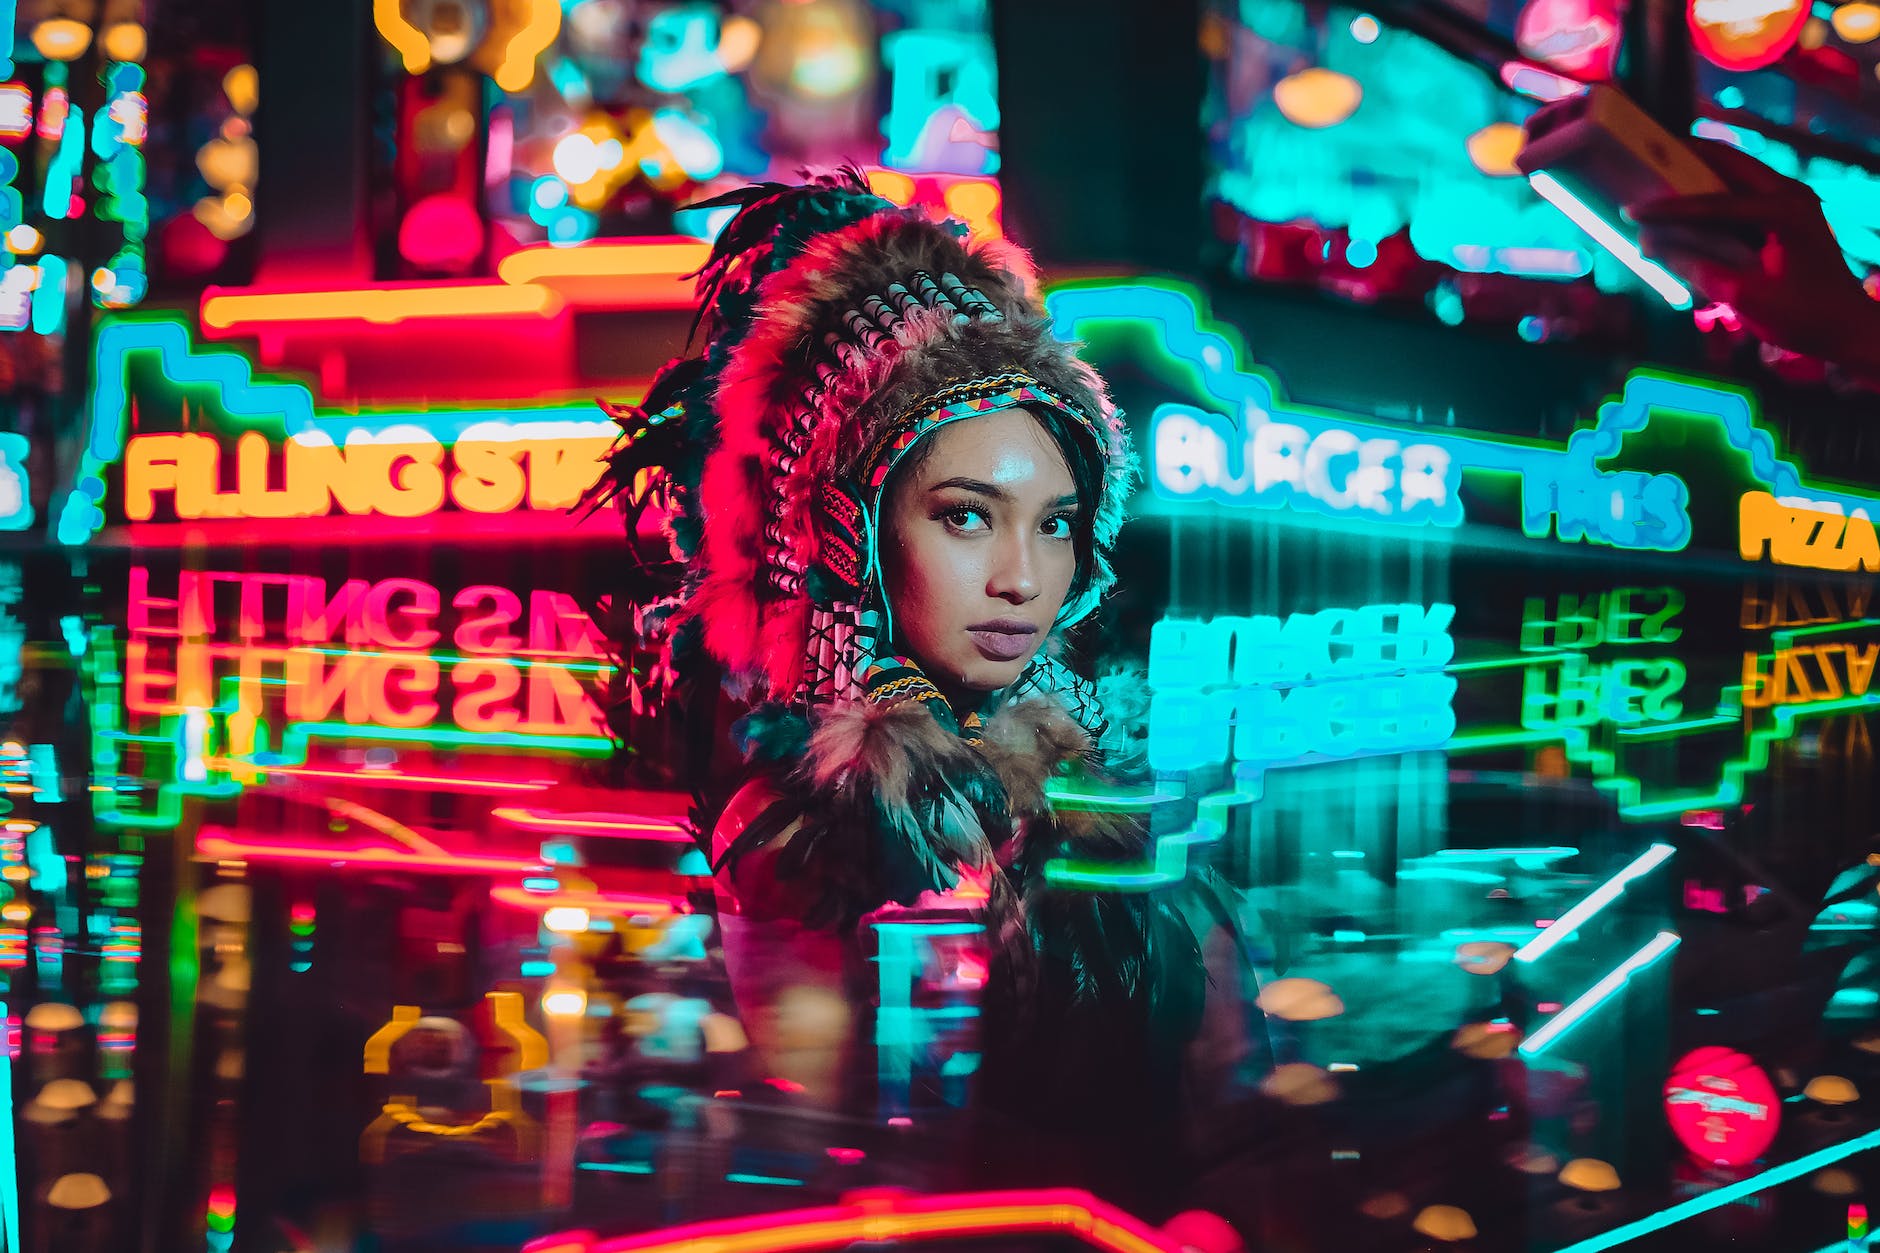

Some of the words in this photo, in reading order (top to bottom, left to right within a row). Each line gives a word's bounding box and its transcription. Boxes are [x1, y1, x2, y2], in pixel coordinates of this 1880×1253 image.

[124, 424, 445, 520] FILLING
[452, 420, 630, 513] STA
[1152, 404, 1461, 524] BURGER
[1739, 490, 1880, 573] PIZZA
